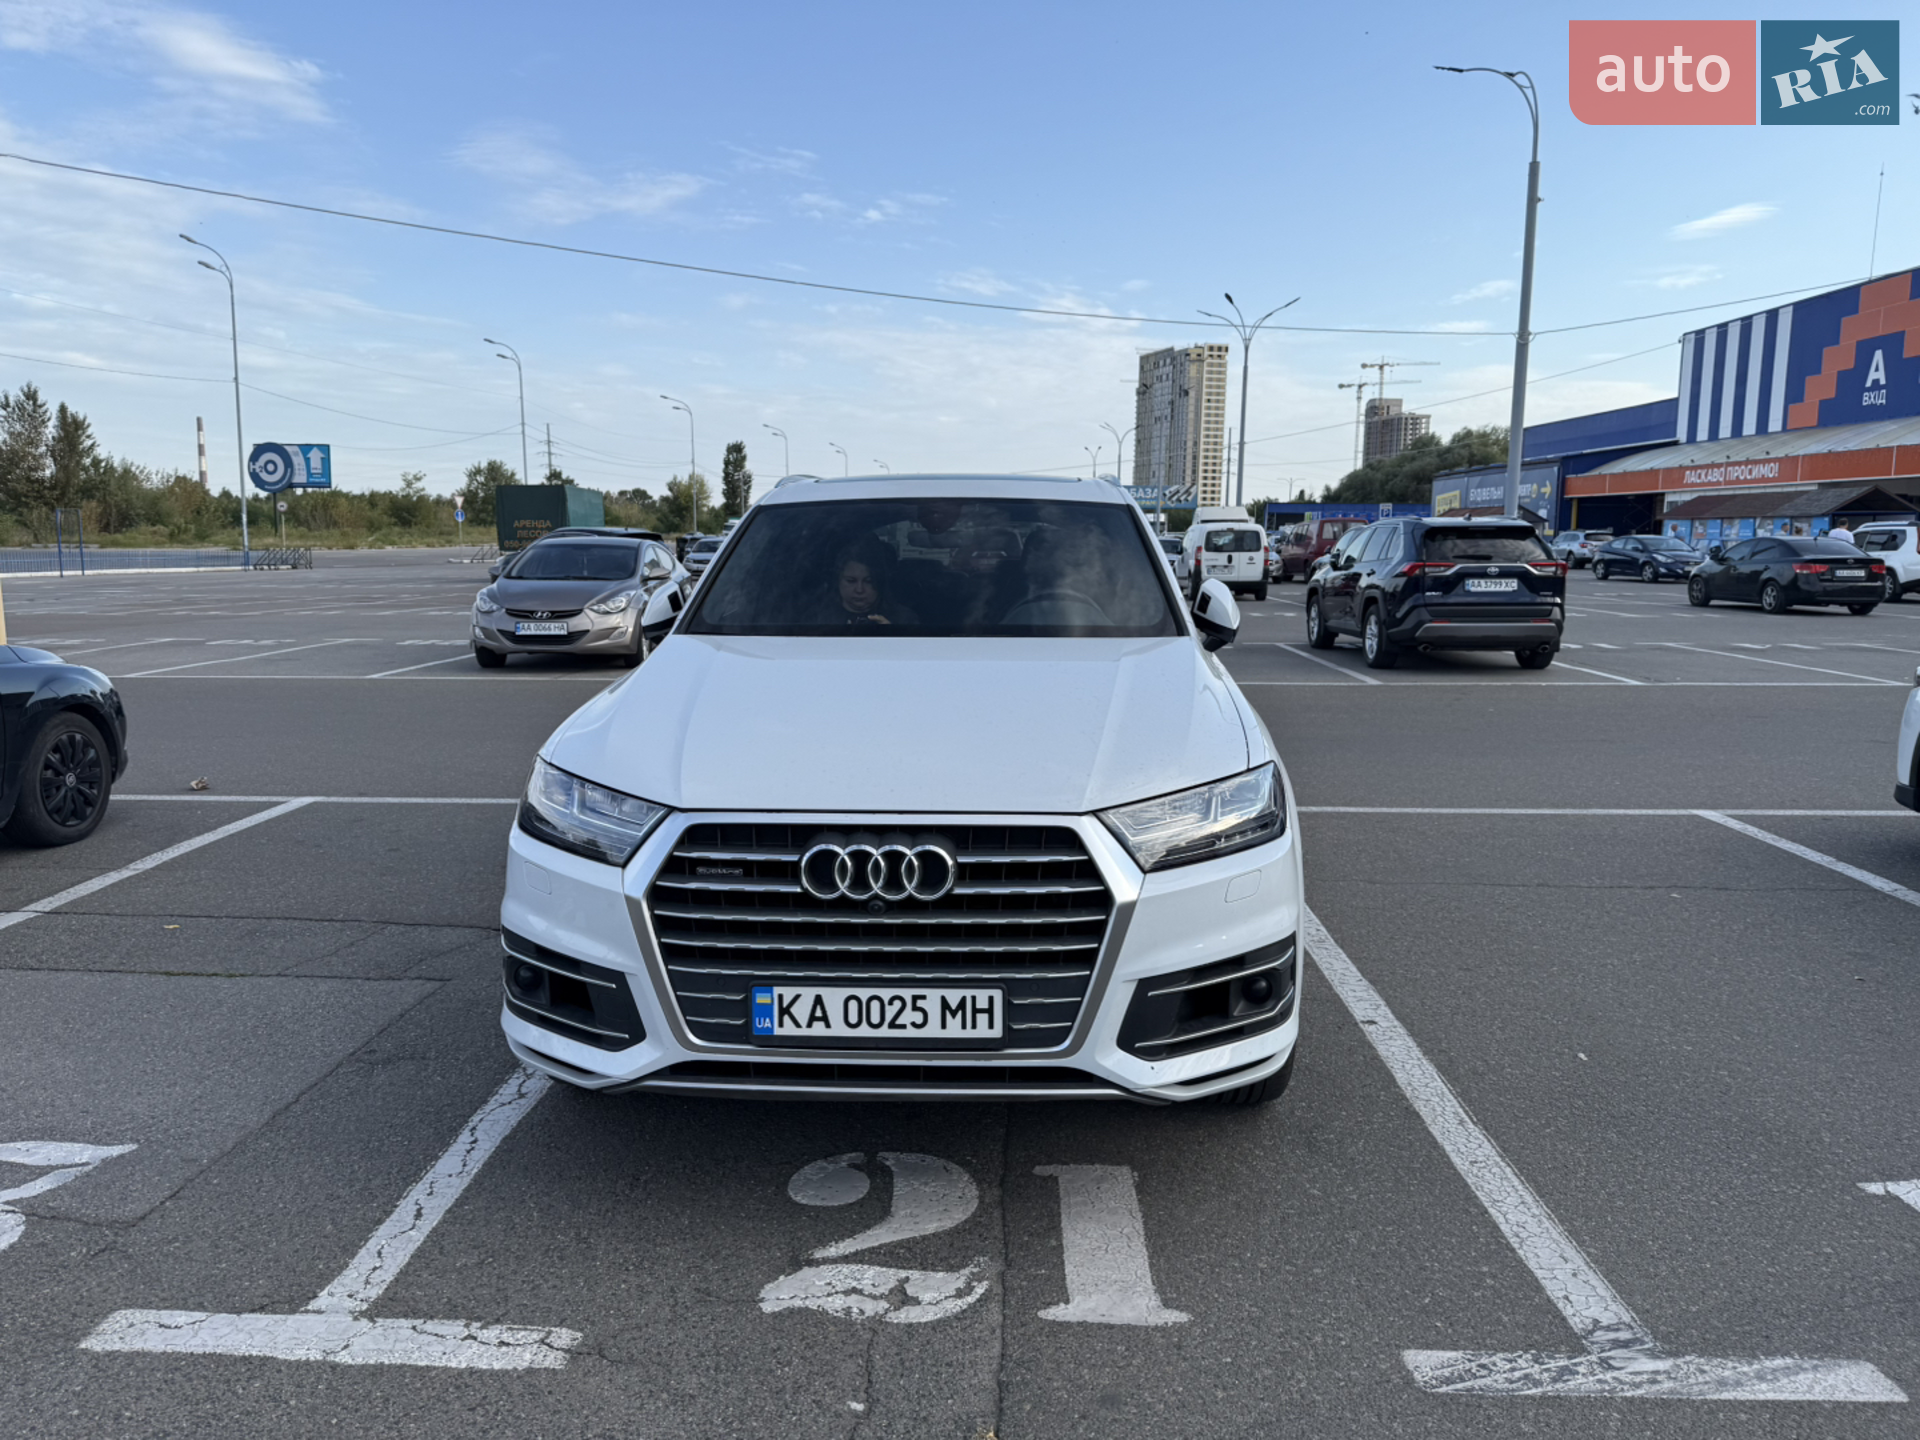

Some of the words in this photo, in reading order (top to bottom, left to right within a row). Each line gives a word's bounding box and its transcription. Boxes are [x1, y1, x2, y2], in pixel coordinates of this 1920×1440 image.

[1865, 349, 1886, 388] А
[1862, 389, 1886, 406] ВХІД
[1683, 467, 1725, 484] ЛАСКАВО
[1726, 462, 1779, 481] ПРОСИМО!
[1128, 487, 1158, 498] БАЗА
[513, 519, 552, 528] АРЕНДА
[521, 623, 531, 632] AA
[777, 994, 831, 1029] KA
[843, 994, 928, 1029] 0025
[941, 995, 994, 1030] MH
[756, 1017, 772, 1029] UA
